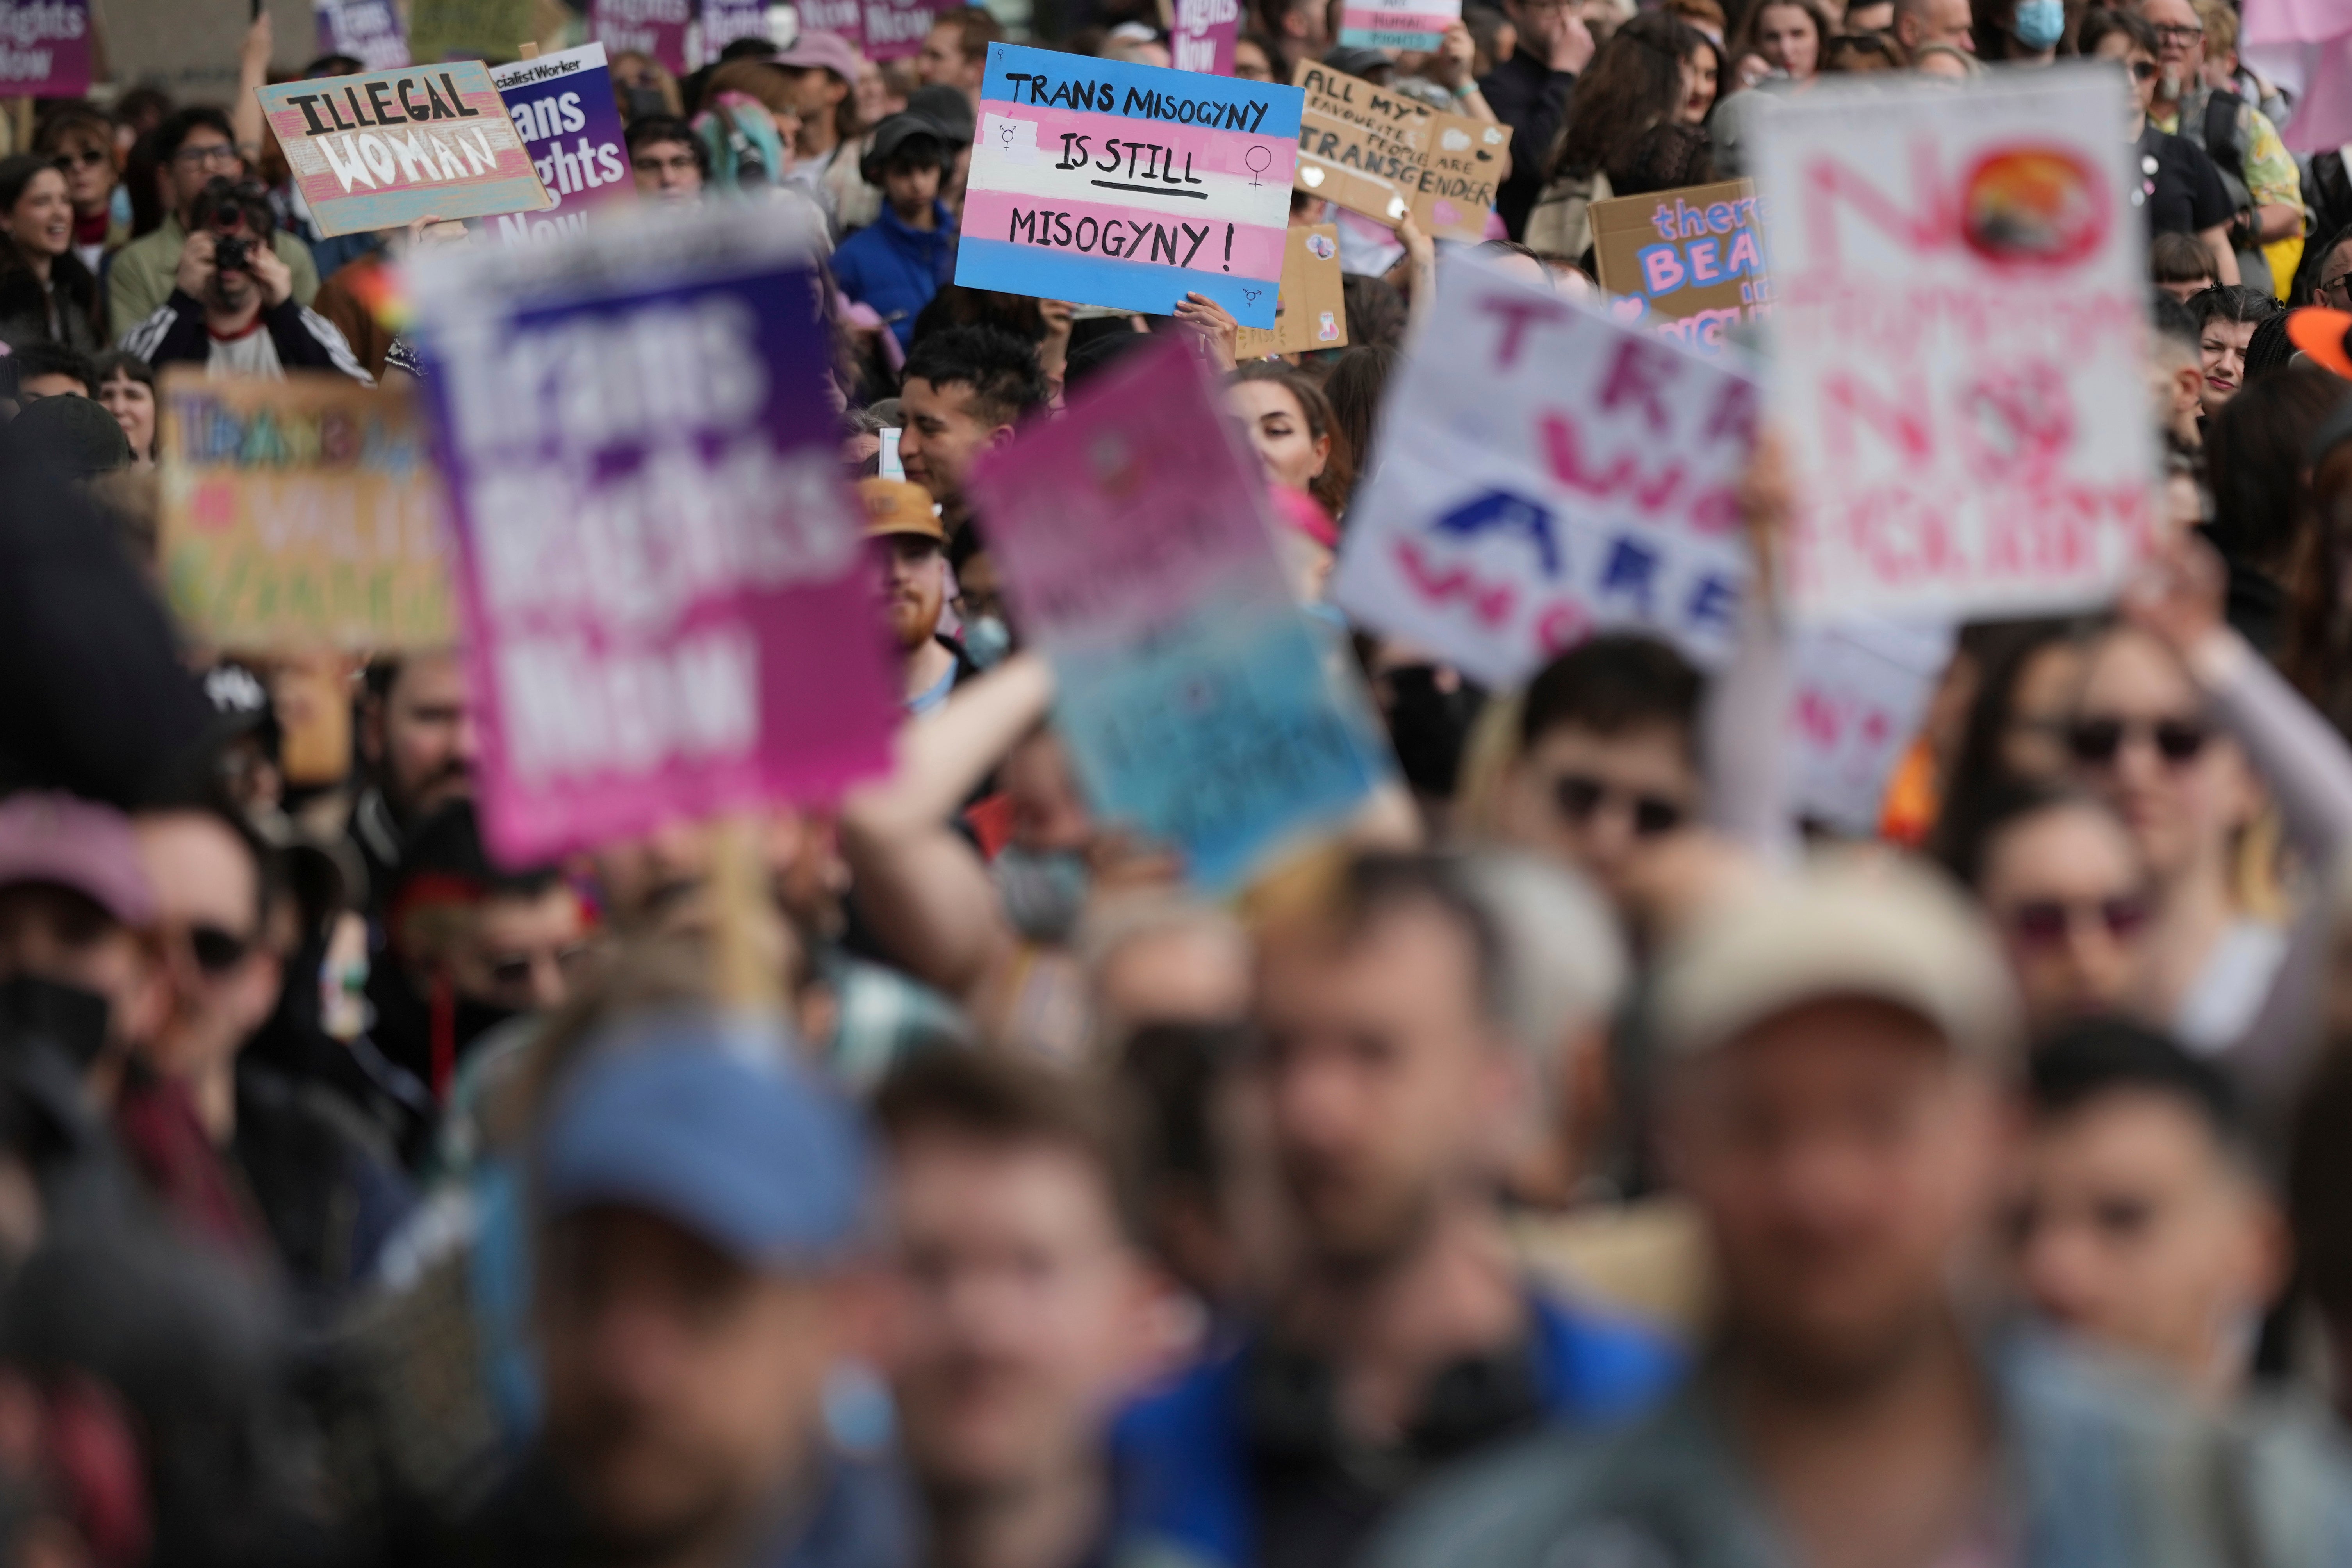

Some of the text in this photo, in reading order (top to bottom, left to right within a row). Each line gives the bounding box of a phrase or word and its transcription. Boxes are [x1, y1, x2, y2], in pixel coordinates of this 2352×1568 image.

[536, 59, 581, 78] Worker
[287, 73, 478, 135] ILLEGAL
[1006, 73, 1269, 134] TRANS MISOGYNY
[1304, 69, 1412, 121] ALL MY
[1311, 96, 1405, 143] FAVOURITE
[316, 127, 497, 194] WOMAN
[1055, 132, 1202, 184] IS STILL
[1299, 125, 1495, 207] TRANSGENDER
[1367, 133, 1475, 175] PEOPLE ARE
